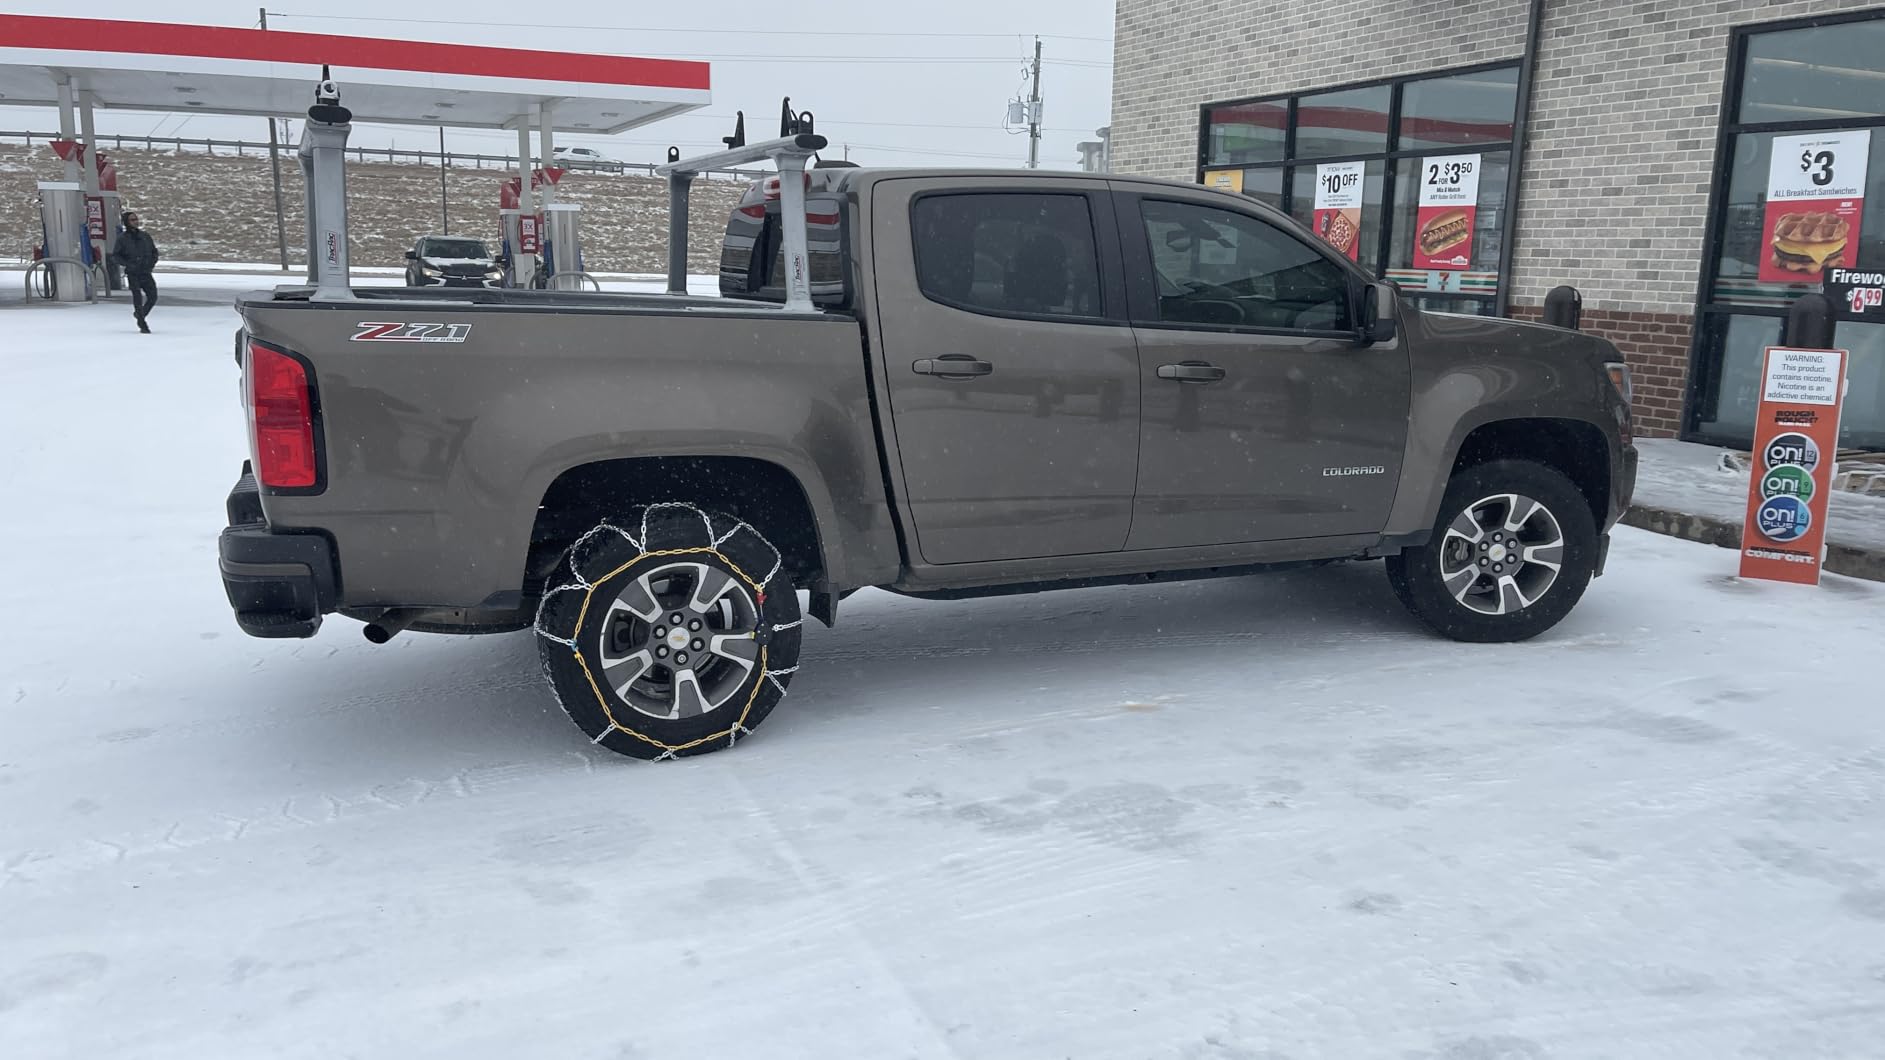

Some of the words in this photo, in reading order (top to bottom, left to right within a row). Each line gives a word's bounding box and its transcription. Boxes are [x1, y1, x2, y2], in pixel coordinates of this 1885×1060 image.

[1801, 150, 1835, 185] $3
[1428, 164, 1439, 184] 2
[1322, 174, 1340, 193] $10
[1342, 173, 1358, 186] OFF
[1786, 188, 1817, 197] Breakfast
[1818, 186, 1857, 196] Sandwiches
[1832, 269, 1885, 285] Firewo
[350, 321, 473, 343] Z71
[1785, 354, 1825, 363] WARNING:
[1798, 365, 1825, 373] product
[1772, 373, 1802, 381] contains
[1803, 375, 1832, 383] nicotine.
[1778, 382, 1807, 391] Nicotine
[1767, 391, 1799, 400] addictive
[1322, 465, 1385, 476] COLORADO
[1763, 520, 1793, 529] PLUS
